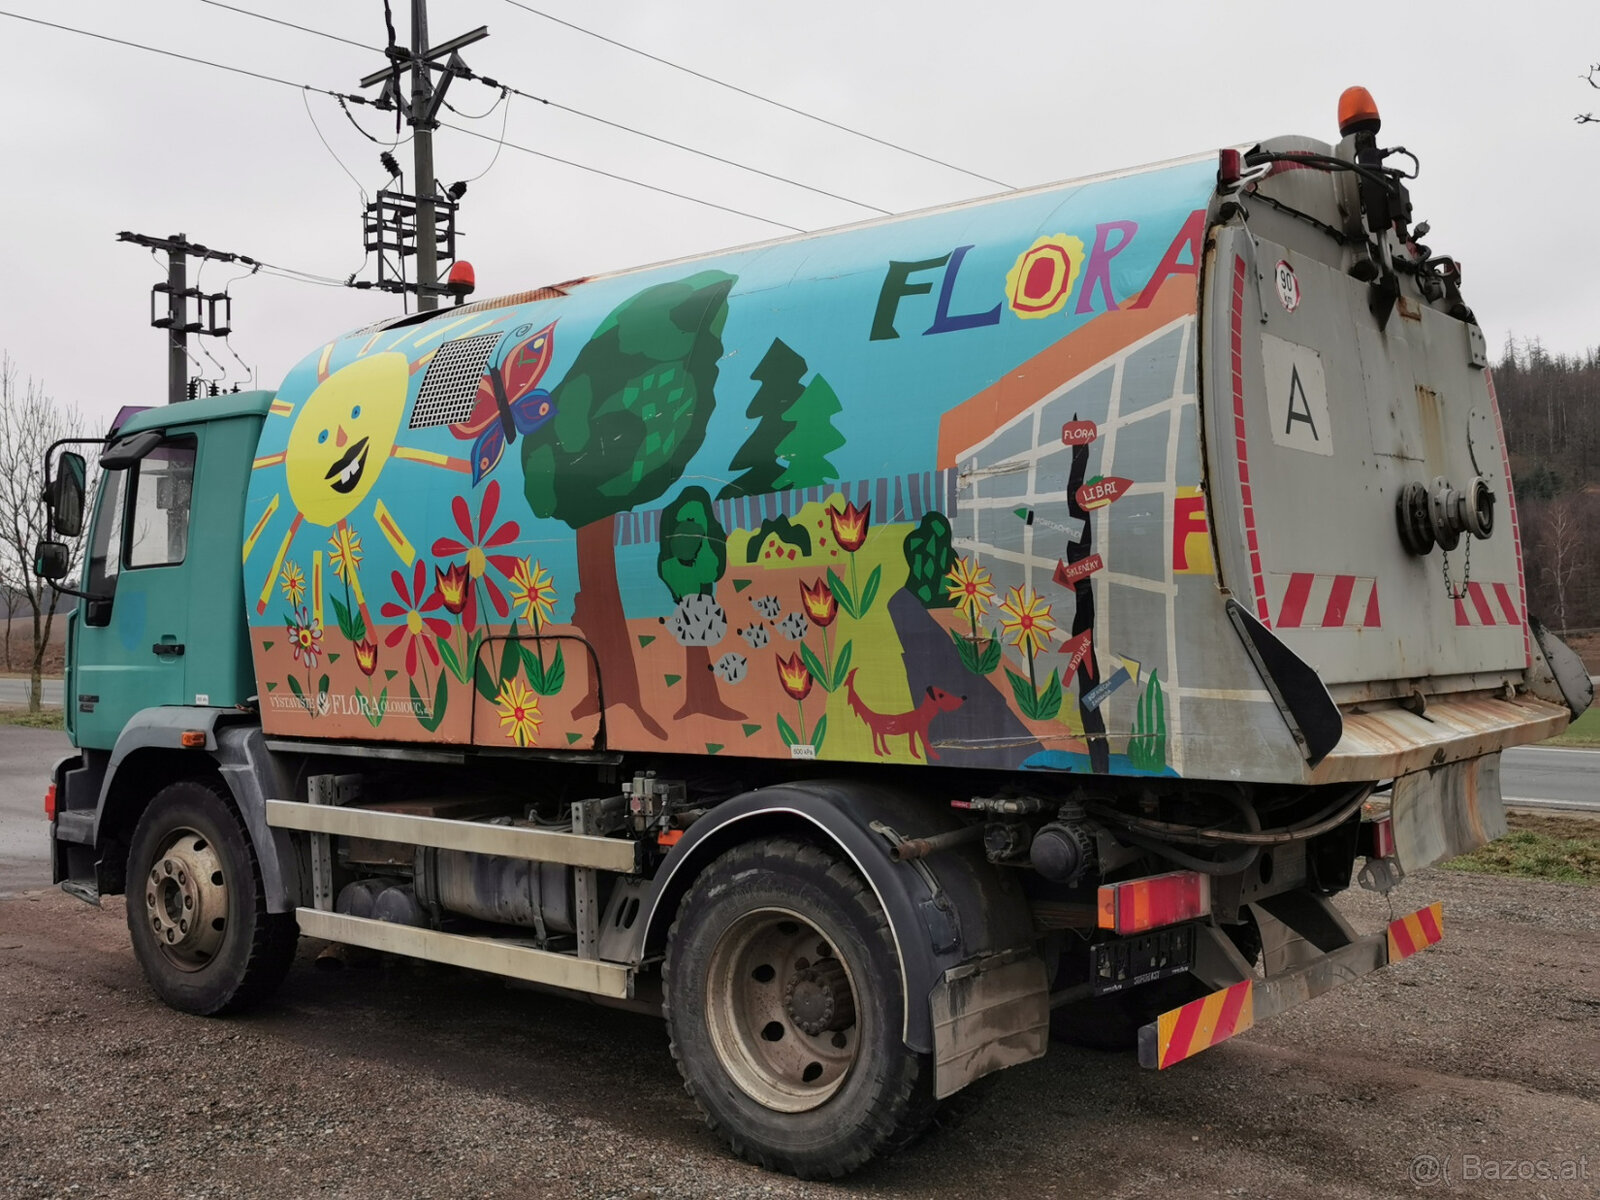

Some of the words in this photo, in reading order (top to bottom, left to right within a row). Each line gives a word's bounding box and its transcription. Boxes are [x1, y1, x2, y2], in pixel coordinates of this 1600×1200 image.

[869, 208, 1207, 342] FLORA
[1279, 269, 1293, 292] 90
[1285, 362, 1319, 441] A
[1063, 428, 1095, 440] FLORA
[1082, 481, 1117, 501] LIBRI
[331, 694, 381, 717] FLORA
